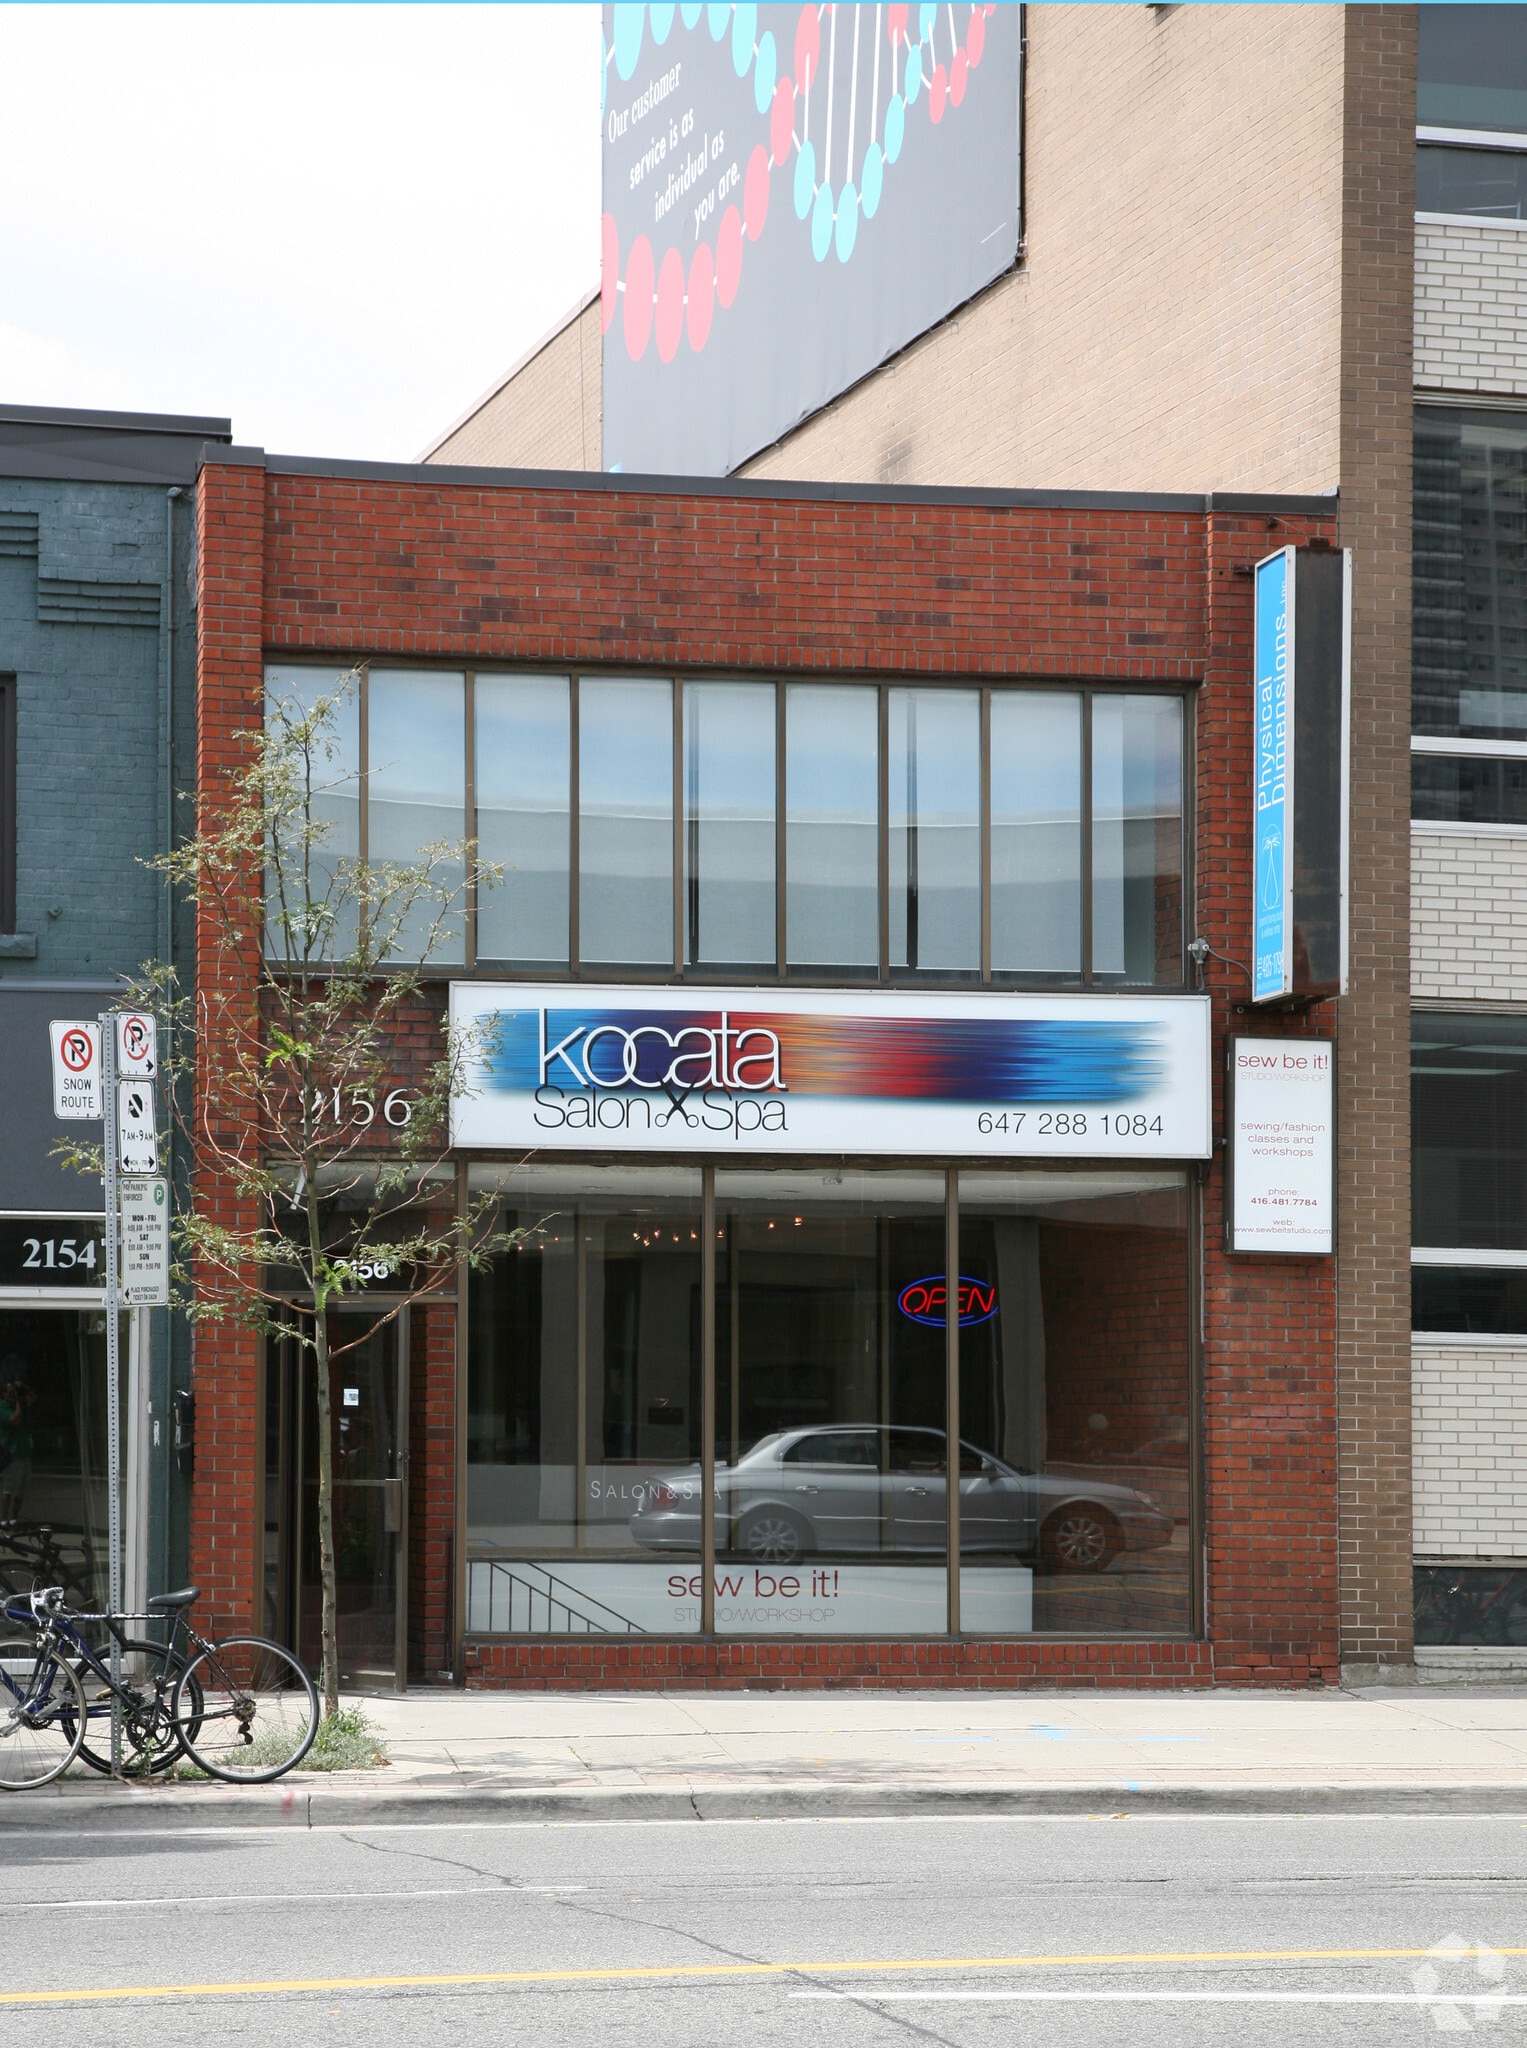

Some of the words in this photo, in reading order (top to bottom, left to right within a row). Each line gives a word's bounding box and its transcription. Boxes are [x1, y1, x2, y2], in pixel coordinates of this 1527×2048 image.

[608, 108, 629, 144] Our
[631, 62, 682, 125] customer
[629, 136, 666, 190] service
[669, 118, 678, 150] is
[681, 107, 694, 138] as
[655, 132, 708, 223] individual
[711, 129, 725, 161] as
[694, 188, 715, 241] you
[718, 162, 741, 201] are.
[1272, 613, 1286, 806] Dimensions
[1258, 676, 1276, 812] Physical
[538, 1008, 789, 1092] kocata
[1237, 1055, 1278, 1068] sew
[1283, 1053, 1308, 1069] be
[1313, 1054, 1328, 1070] it!
[63, 1078, 92, 1091] SNOW
[61, 1096, 94, 1109] ROUTE
[298, 1087, 412, 1126] 2156
[533, 1085, 651, 1129] Salon
[701, 1088, 789, 1140] Spa
[977, 1112, 1027, 1134] 647
[1038, 1113, 1088, 1135] 288
[1100, 1114, 1164, 1136] 1084
[1240, 1122, 1325, 1133] sewing/fashion
[1247, 1134, 1290, 1144] classes
[1292, 1135, 1315, 1144] and
[1251, 1147, 1314, 1158] workshops
[1250, 1197, 1318, 1207] 416.481.7784
[1268, 1188, 1300, 1196] phone:
[1233, 1226, 1331, 1235] www.sewbeitstudio.com
[22, 1238, 97, 1269] 2154
[902, 1287, 995, 1314] OPEN
[667, 1575, 744, 1598] sew
[755, 1569, 801, 1598] be
[812, 1569, 839, 1598] it!
